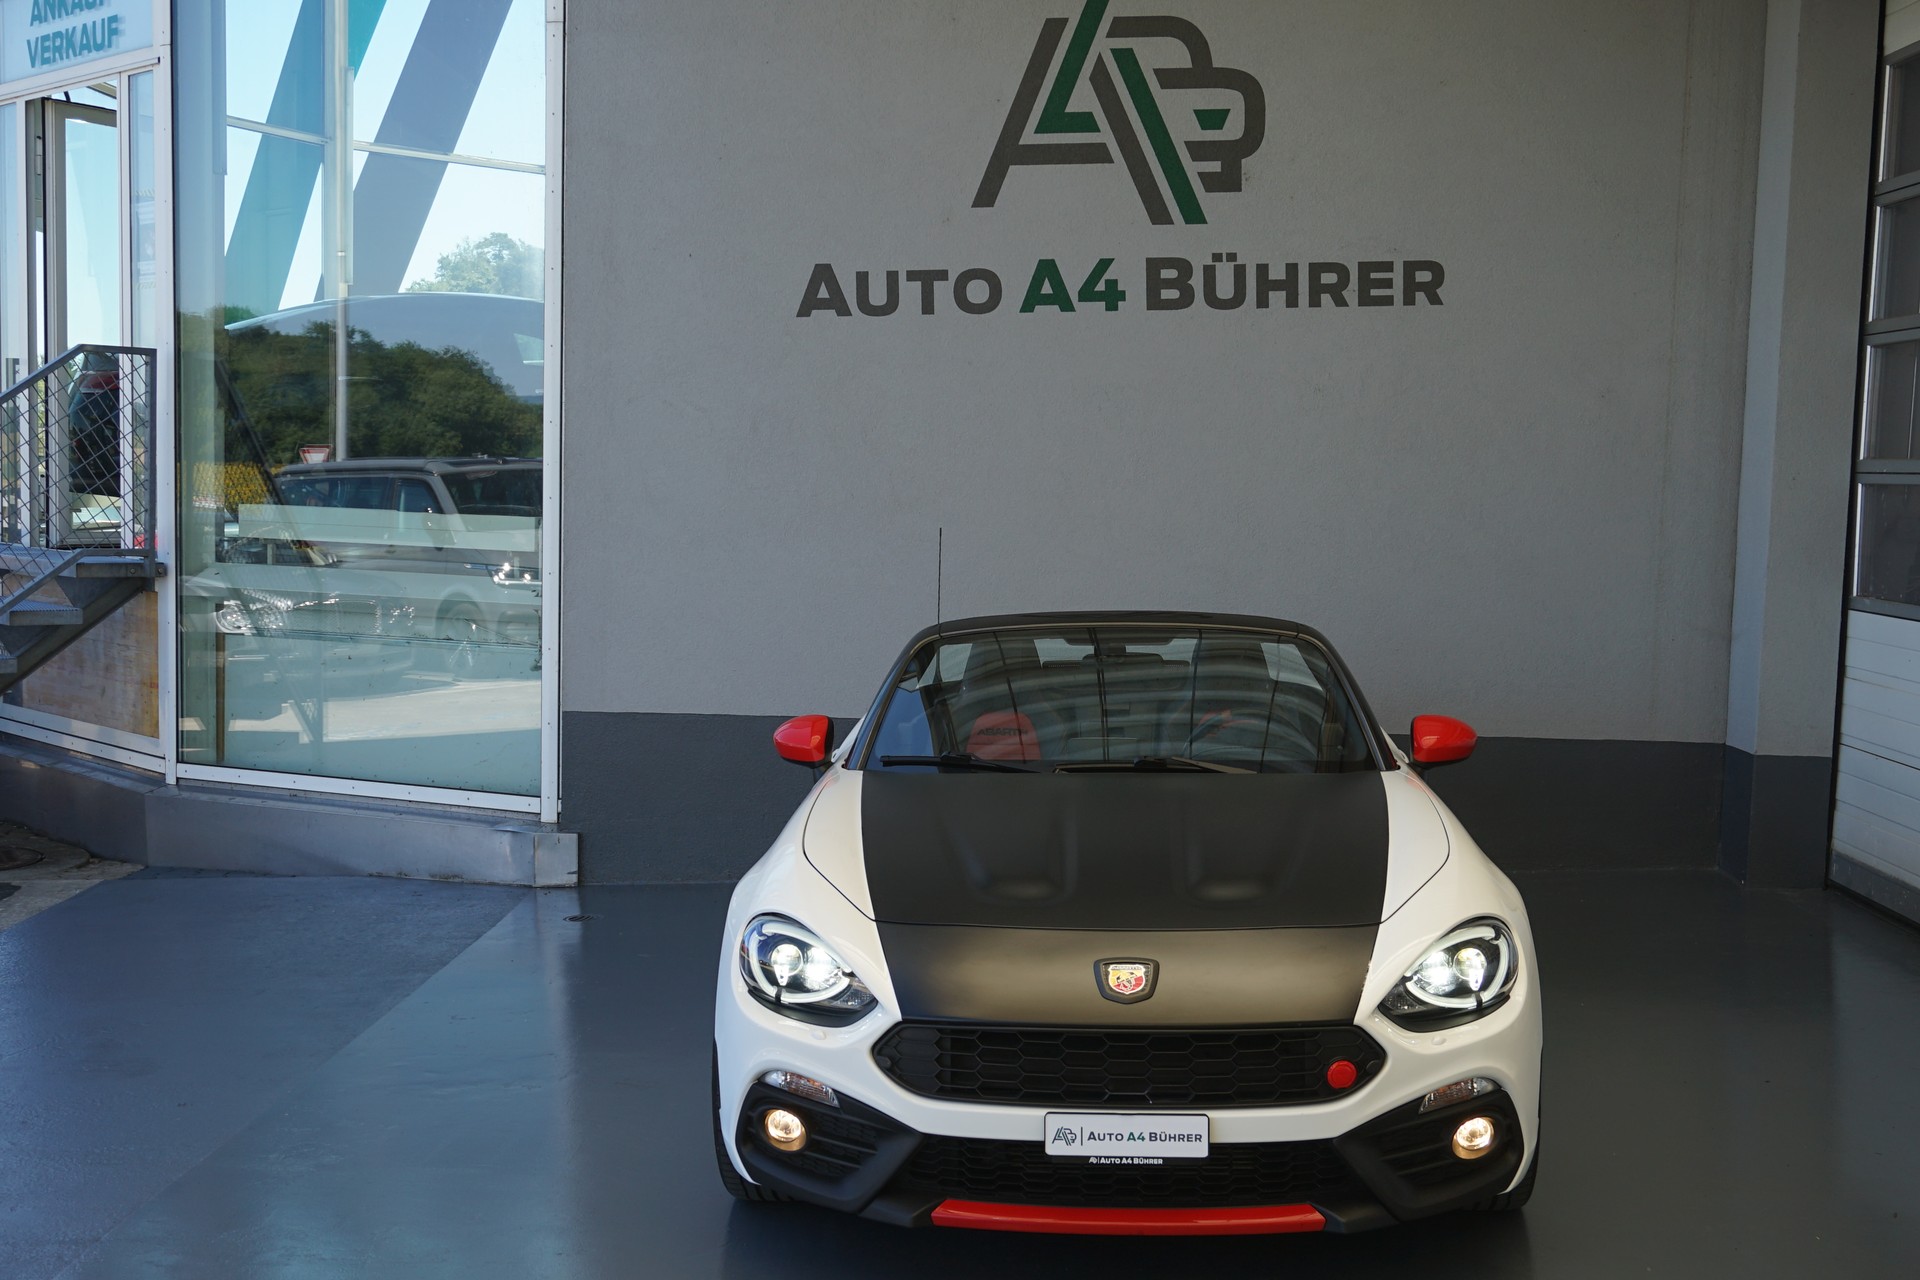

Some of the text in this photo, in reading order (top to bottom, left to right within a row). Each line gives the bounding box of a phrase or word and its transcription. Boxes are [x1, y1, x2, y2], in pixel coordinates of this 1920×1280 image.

[30, 0, 104, 26] ANK
[27, 15, 119, 68] VERKAUF
[796, 252, 1446, 318] AUTO A4 BÜHRER
[1087, 1131, 1203, 1143] AUTO A4 BÜHRER
[1133, 1157, 1164, 1165] BÜHRER
